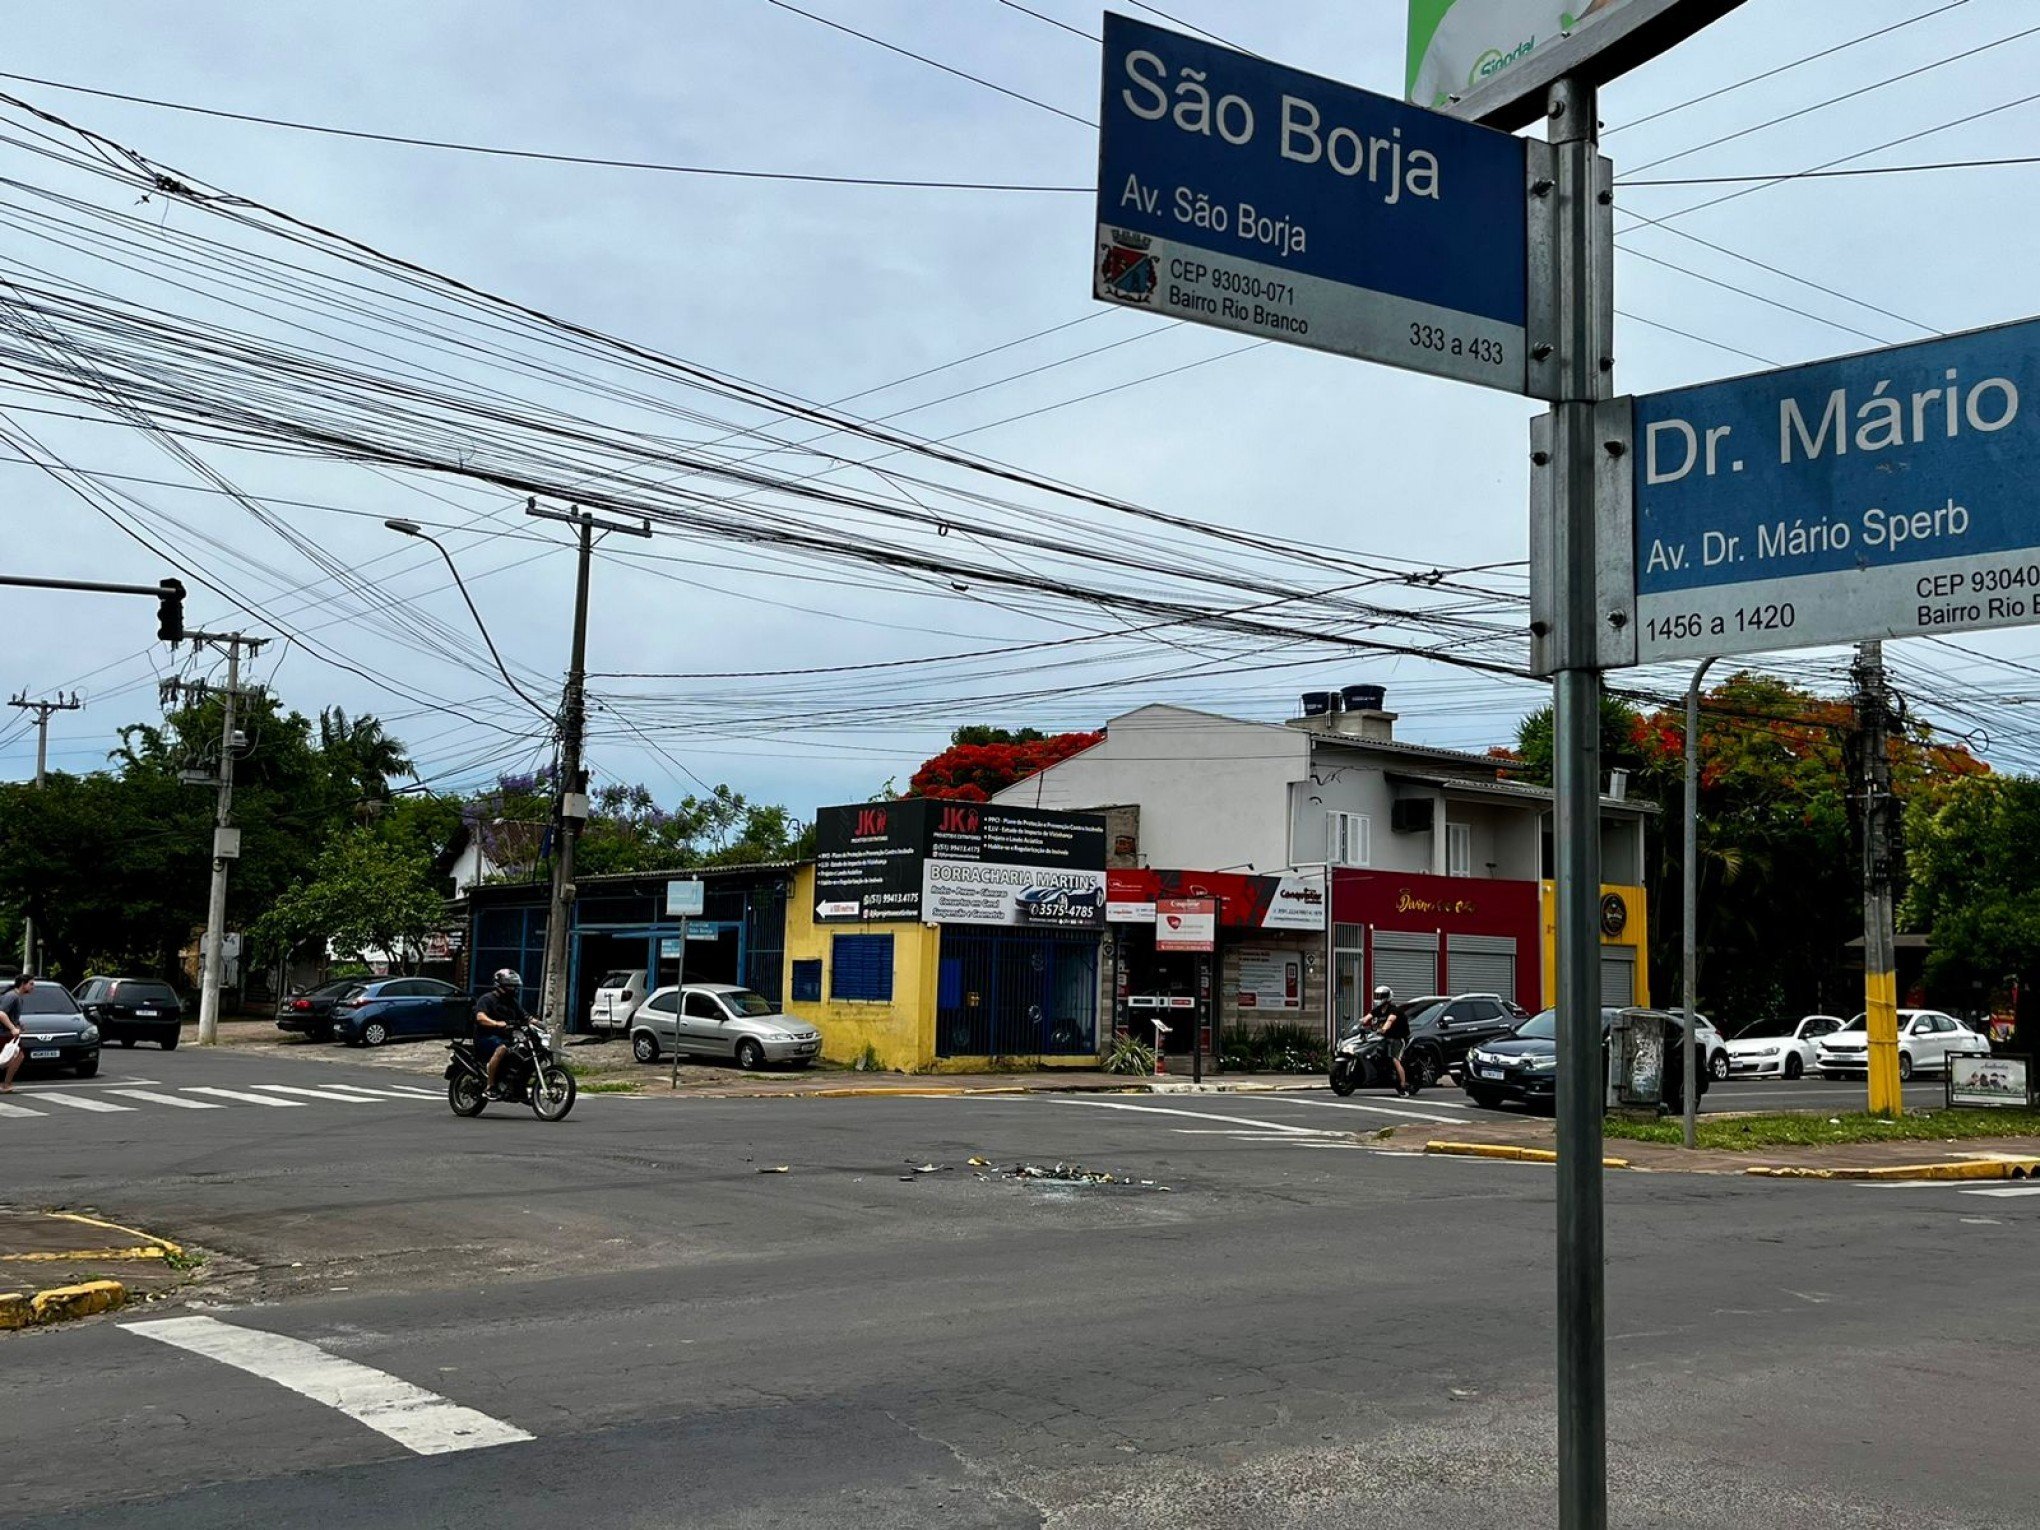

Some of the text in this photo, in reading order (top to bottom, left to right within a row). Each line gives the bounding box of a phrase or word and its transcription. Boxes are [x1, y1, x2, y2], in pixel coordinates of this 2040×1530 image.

[1122, 50, 1440, 205] São Borja
[1120, 173, 1307, 257] Av. São Borja
[1170, 258, 1294, 306] CEP 93030-071
[1169, 284, 1309, 335] Bairro Rio Branco
[1410, 322, 1504, 365] 333 a 433
[1646, 368, 2019, 486] Dr. Mário
[1646, 498, 1970, 575] Av. Dr. Mário Sperb
[1916, 565, 2040, 598] CEP 93040
[1646, 602, 1796, 643] 1456 a 1420
[1918, 602, 1980, 626] Bairro
[1988, 597, 2025, 619] Rio
[931, 865, 1034, 886] BORRACHARIA
[1036, 872, 1097, 890] MARTINS
[1039, 903, 1094, 918] 3575-4785
